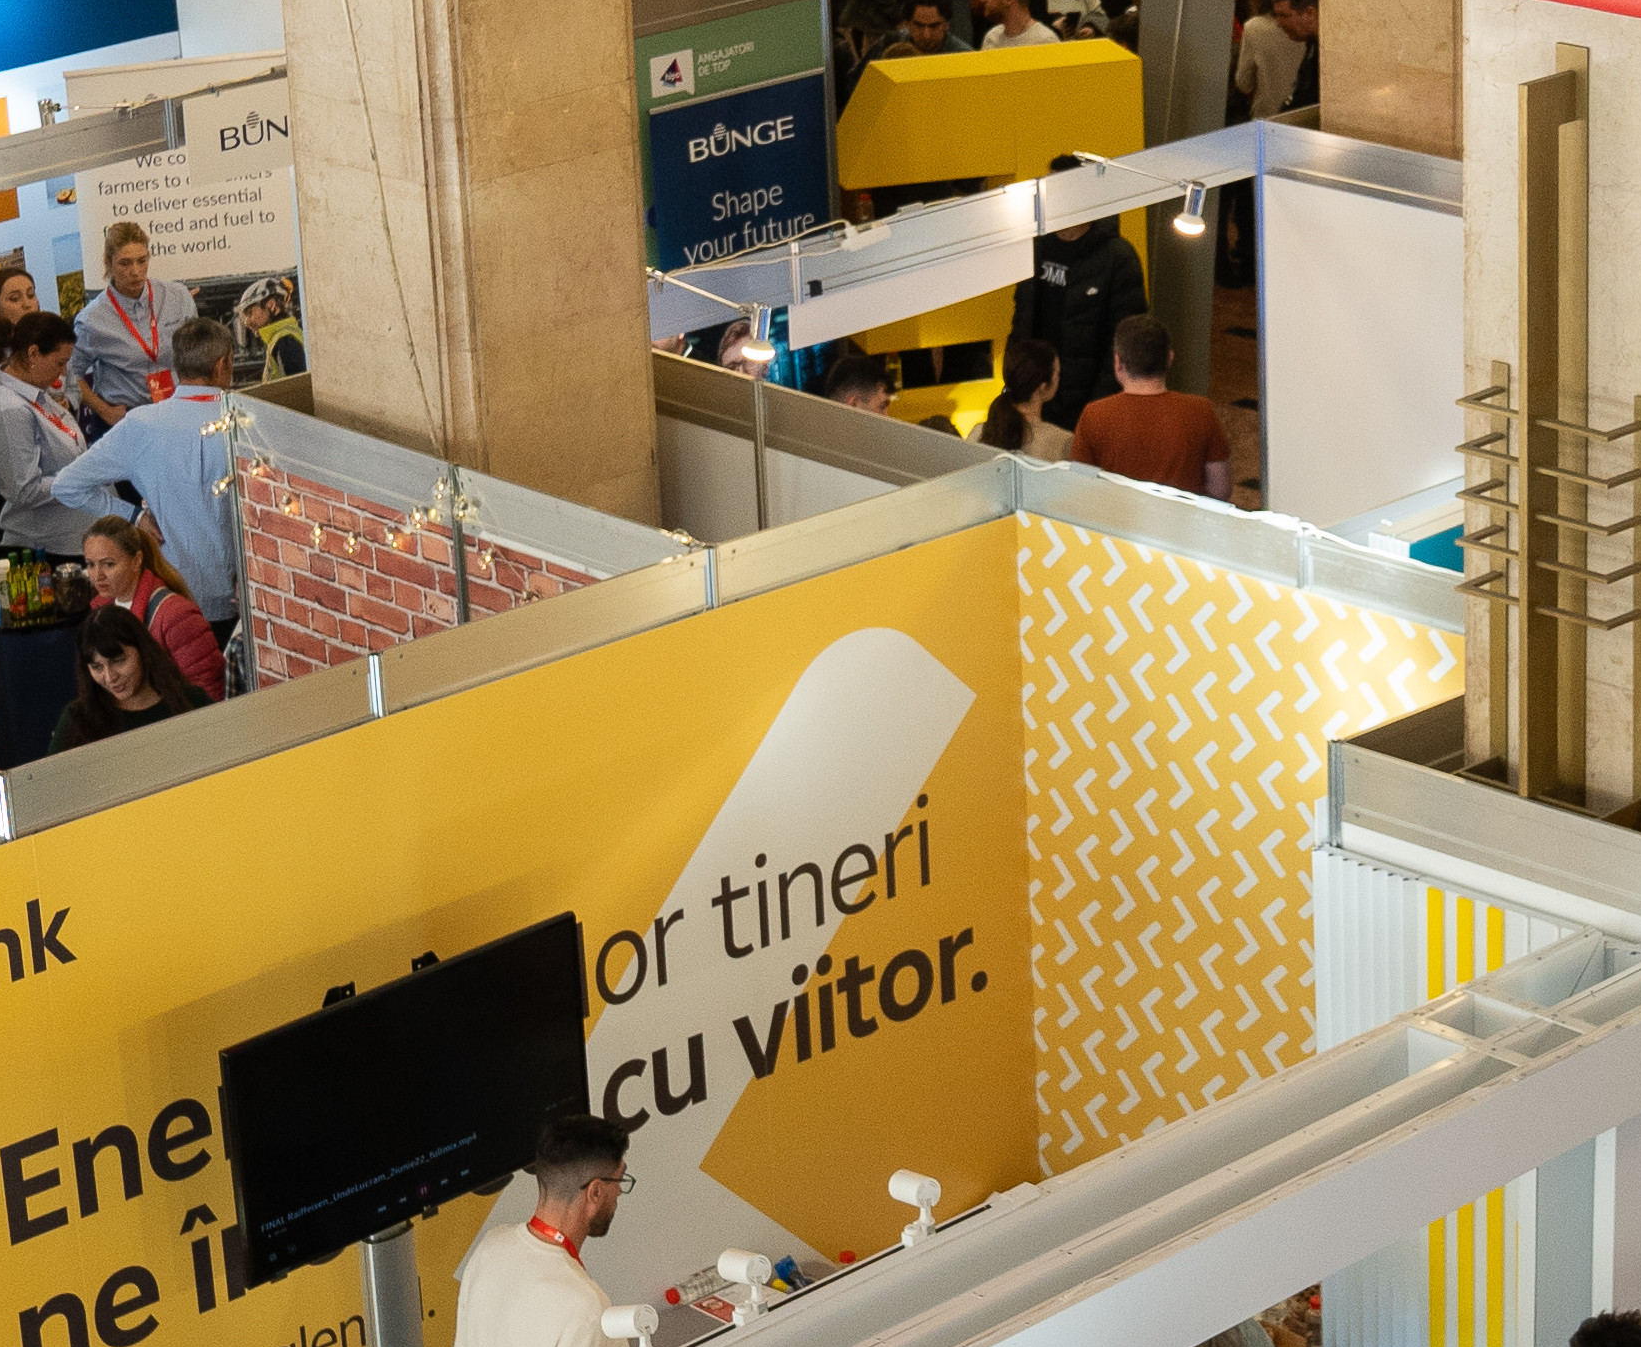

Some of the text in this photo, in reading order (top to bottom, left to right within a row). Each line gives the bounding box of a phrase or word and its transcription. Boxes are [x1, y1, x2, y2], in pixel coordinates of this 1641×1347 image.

[697, 42, 755, 64] ANGAJATORI
[711, 59, 732, 75] TOP
[220, 115, 290, 152] BUN
[688, 115, 796, 164] BUNGE
[98, 177, 160, 196] farmers
[165, 175, 181, 189] to
[112, 187, 263, 217] to deliver essential
[712, 184, 784, 222] Shape
[149, 207, 276, 234] feed and fuel to
[150, 234, 232, 256] the world.
[683, 212, 815, 267] your future
[711, 794, 931, 959] tineri
[601, 928, 989, 1135] cu viitor.
